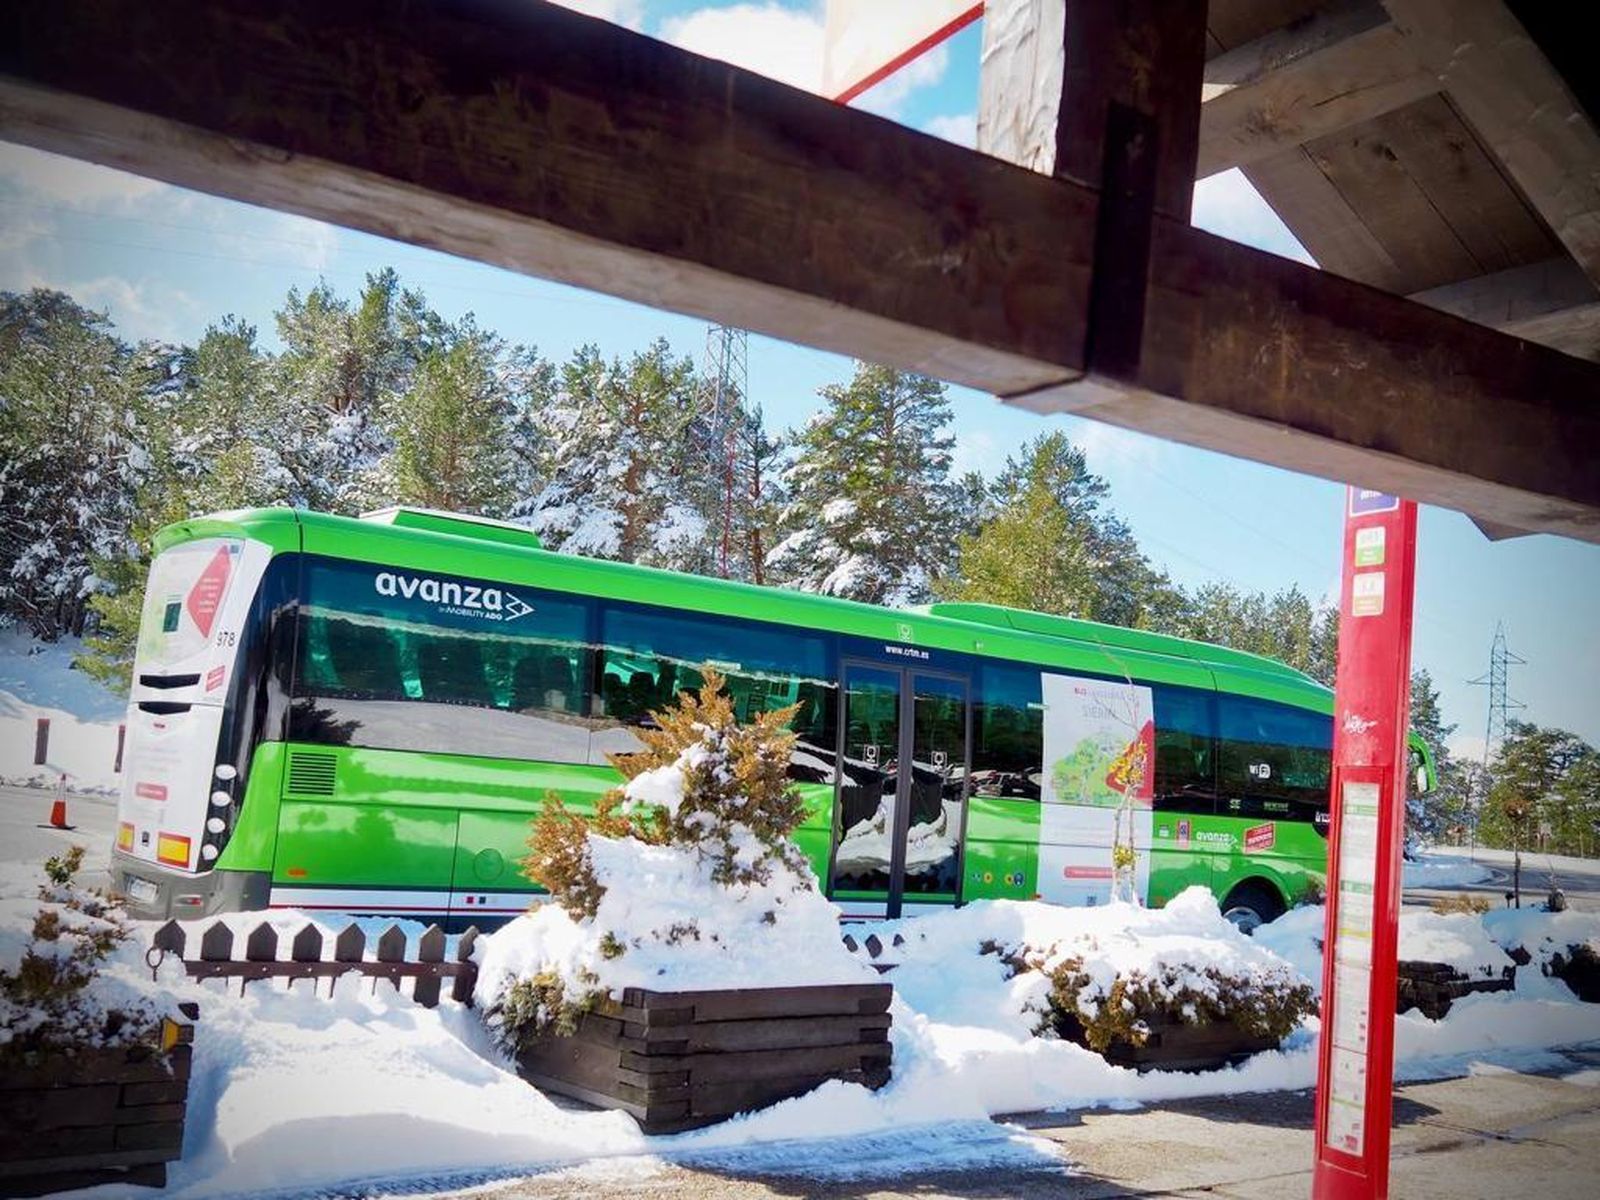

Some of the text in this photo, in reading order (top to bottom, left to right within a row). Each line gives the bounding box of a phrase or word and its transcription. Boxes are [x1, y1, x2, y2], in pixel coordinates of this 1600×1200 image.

[375, 572, 503, 611] avanza
[446, 606, 484, 618] MOBILITY
[885, 646, 929, 659] www.crtm.es
[1196, 831, 1230, 843] avanza
